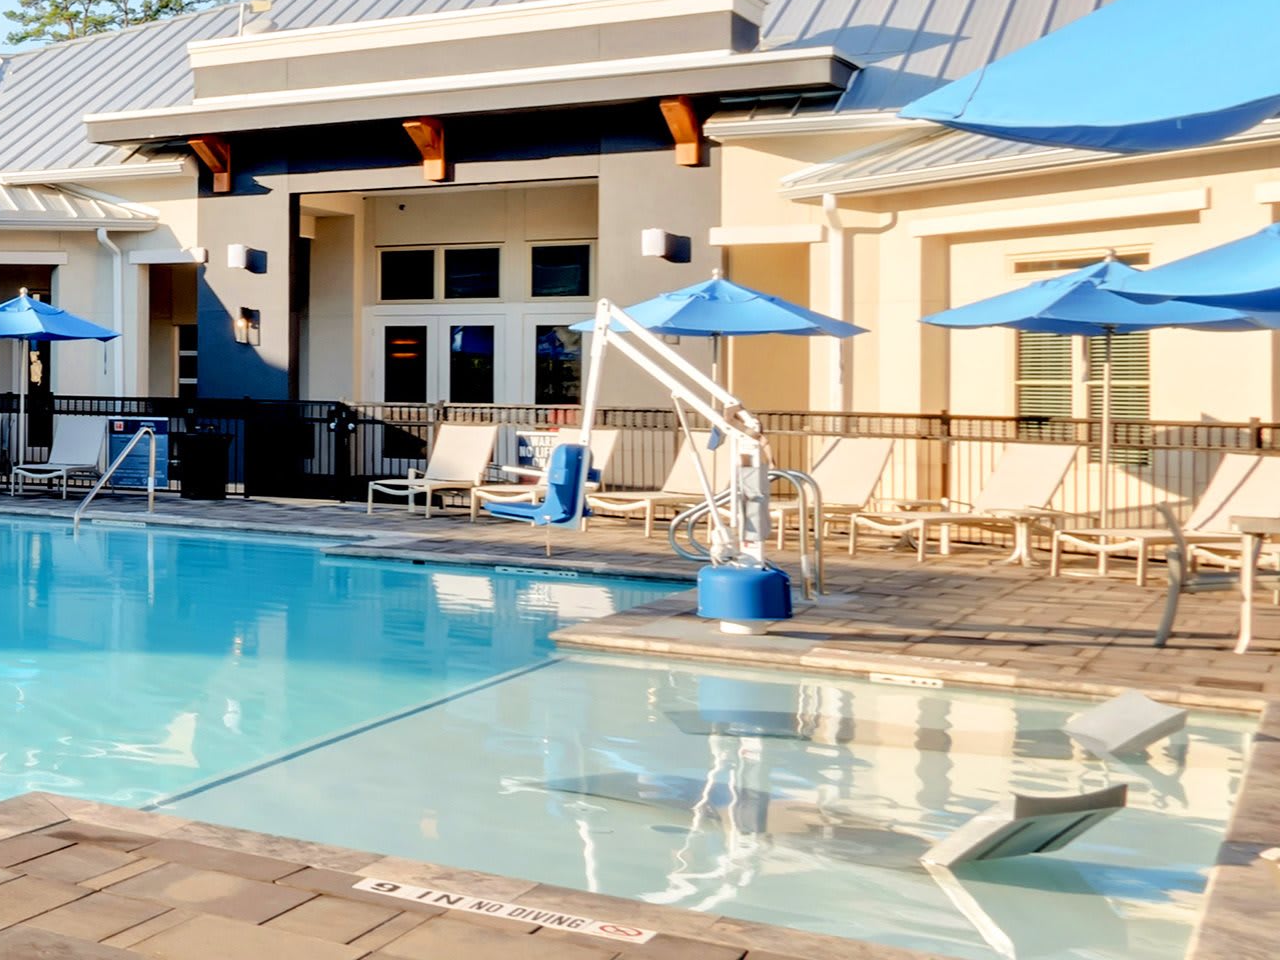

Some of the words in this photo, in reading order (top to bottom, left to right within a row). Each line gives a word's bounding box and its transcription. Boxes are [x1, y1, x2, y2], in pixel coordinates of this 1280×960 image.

[519, 445, 534, 457] NO
[416, 890, 464, 906] IN
[469, 900, 504, 914] NO
[508, 907, 586, 929] DIVING
